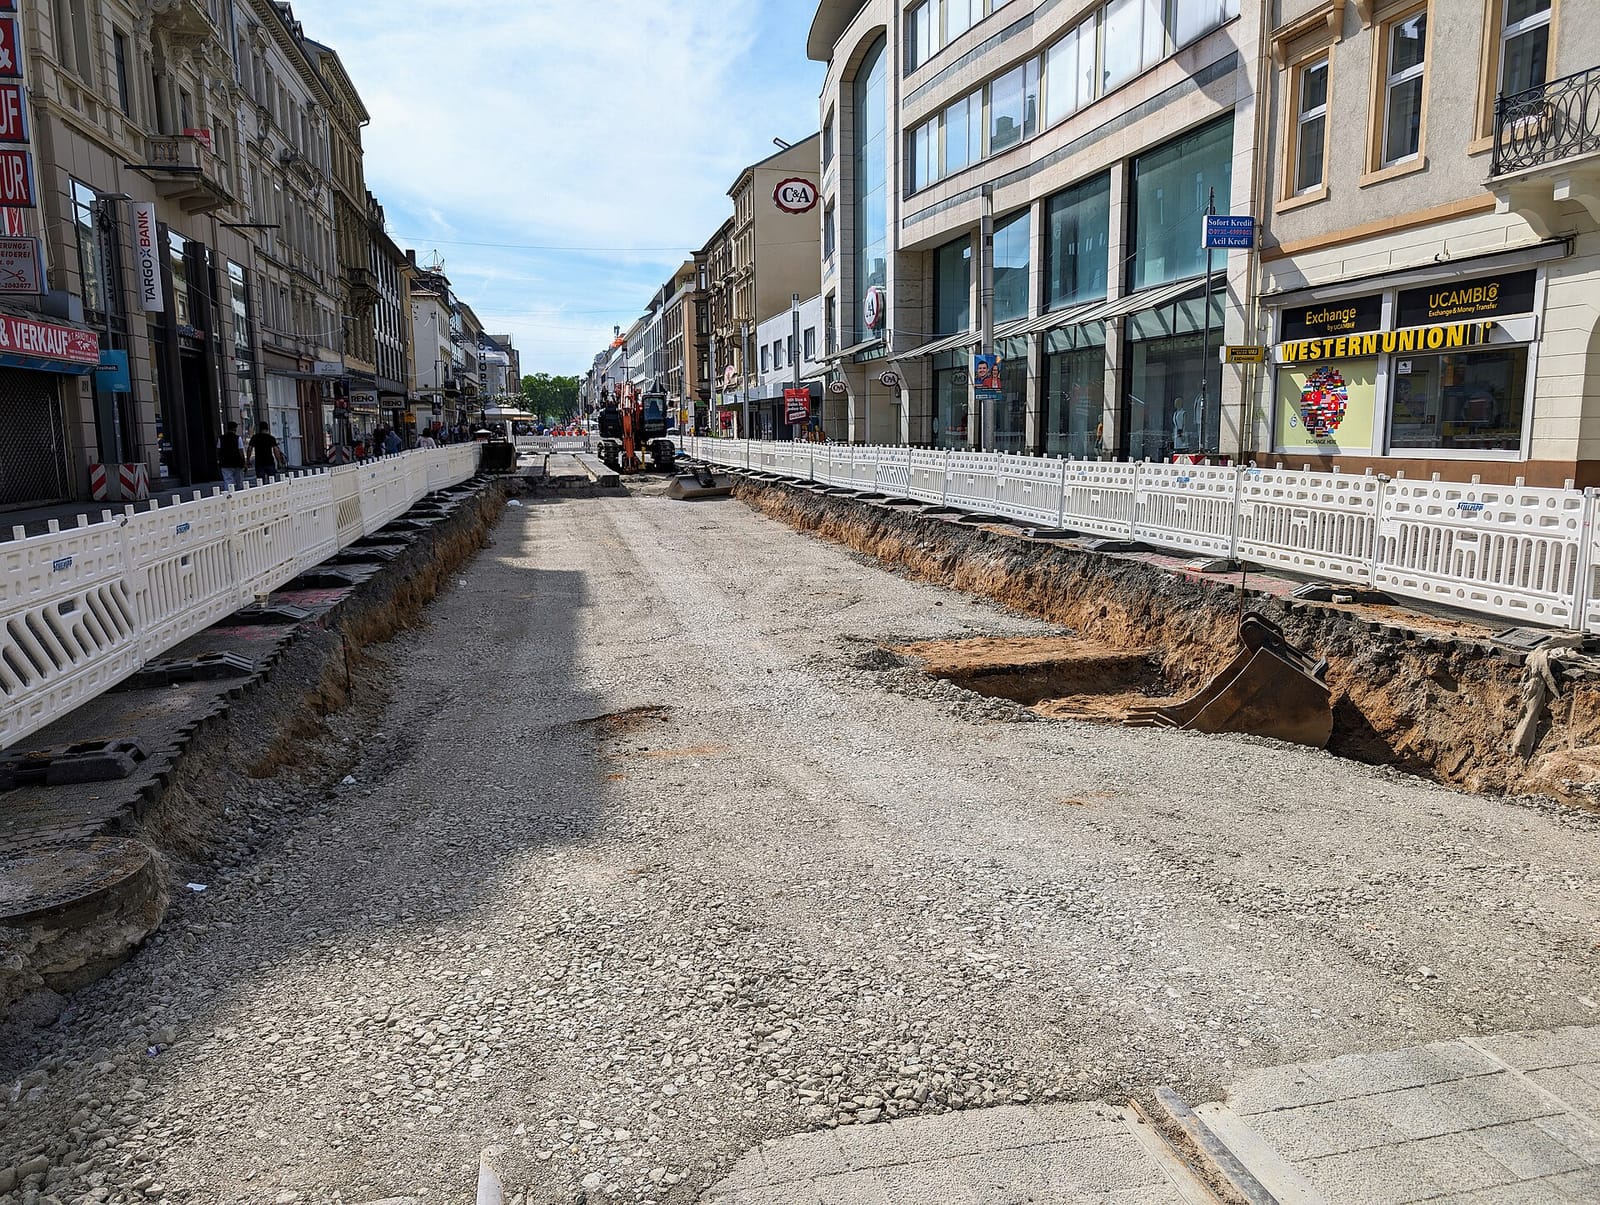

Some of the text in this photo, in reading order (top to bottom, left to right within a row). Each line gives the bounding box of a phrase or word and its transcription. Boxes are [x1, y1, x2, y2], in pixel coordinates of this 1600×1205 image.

[782, 187, 810, 203] C&A
[1208, 218, 1253, 227] Sofort Kredit
[1212, 237, 1248, 245] Acil Kredi
[1476, 303, 1498, 311] Transfer
[1305, 307, 1357, 325] Exchange
[1326, 324, 1333, 332] by
[11, 320, 69, 356] VERKAUF
[1282, 324, 1465, 362] WESTERN UNION
[351, 394, 374, 403] RENO
